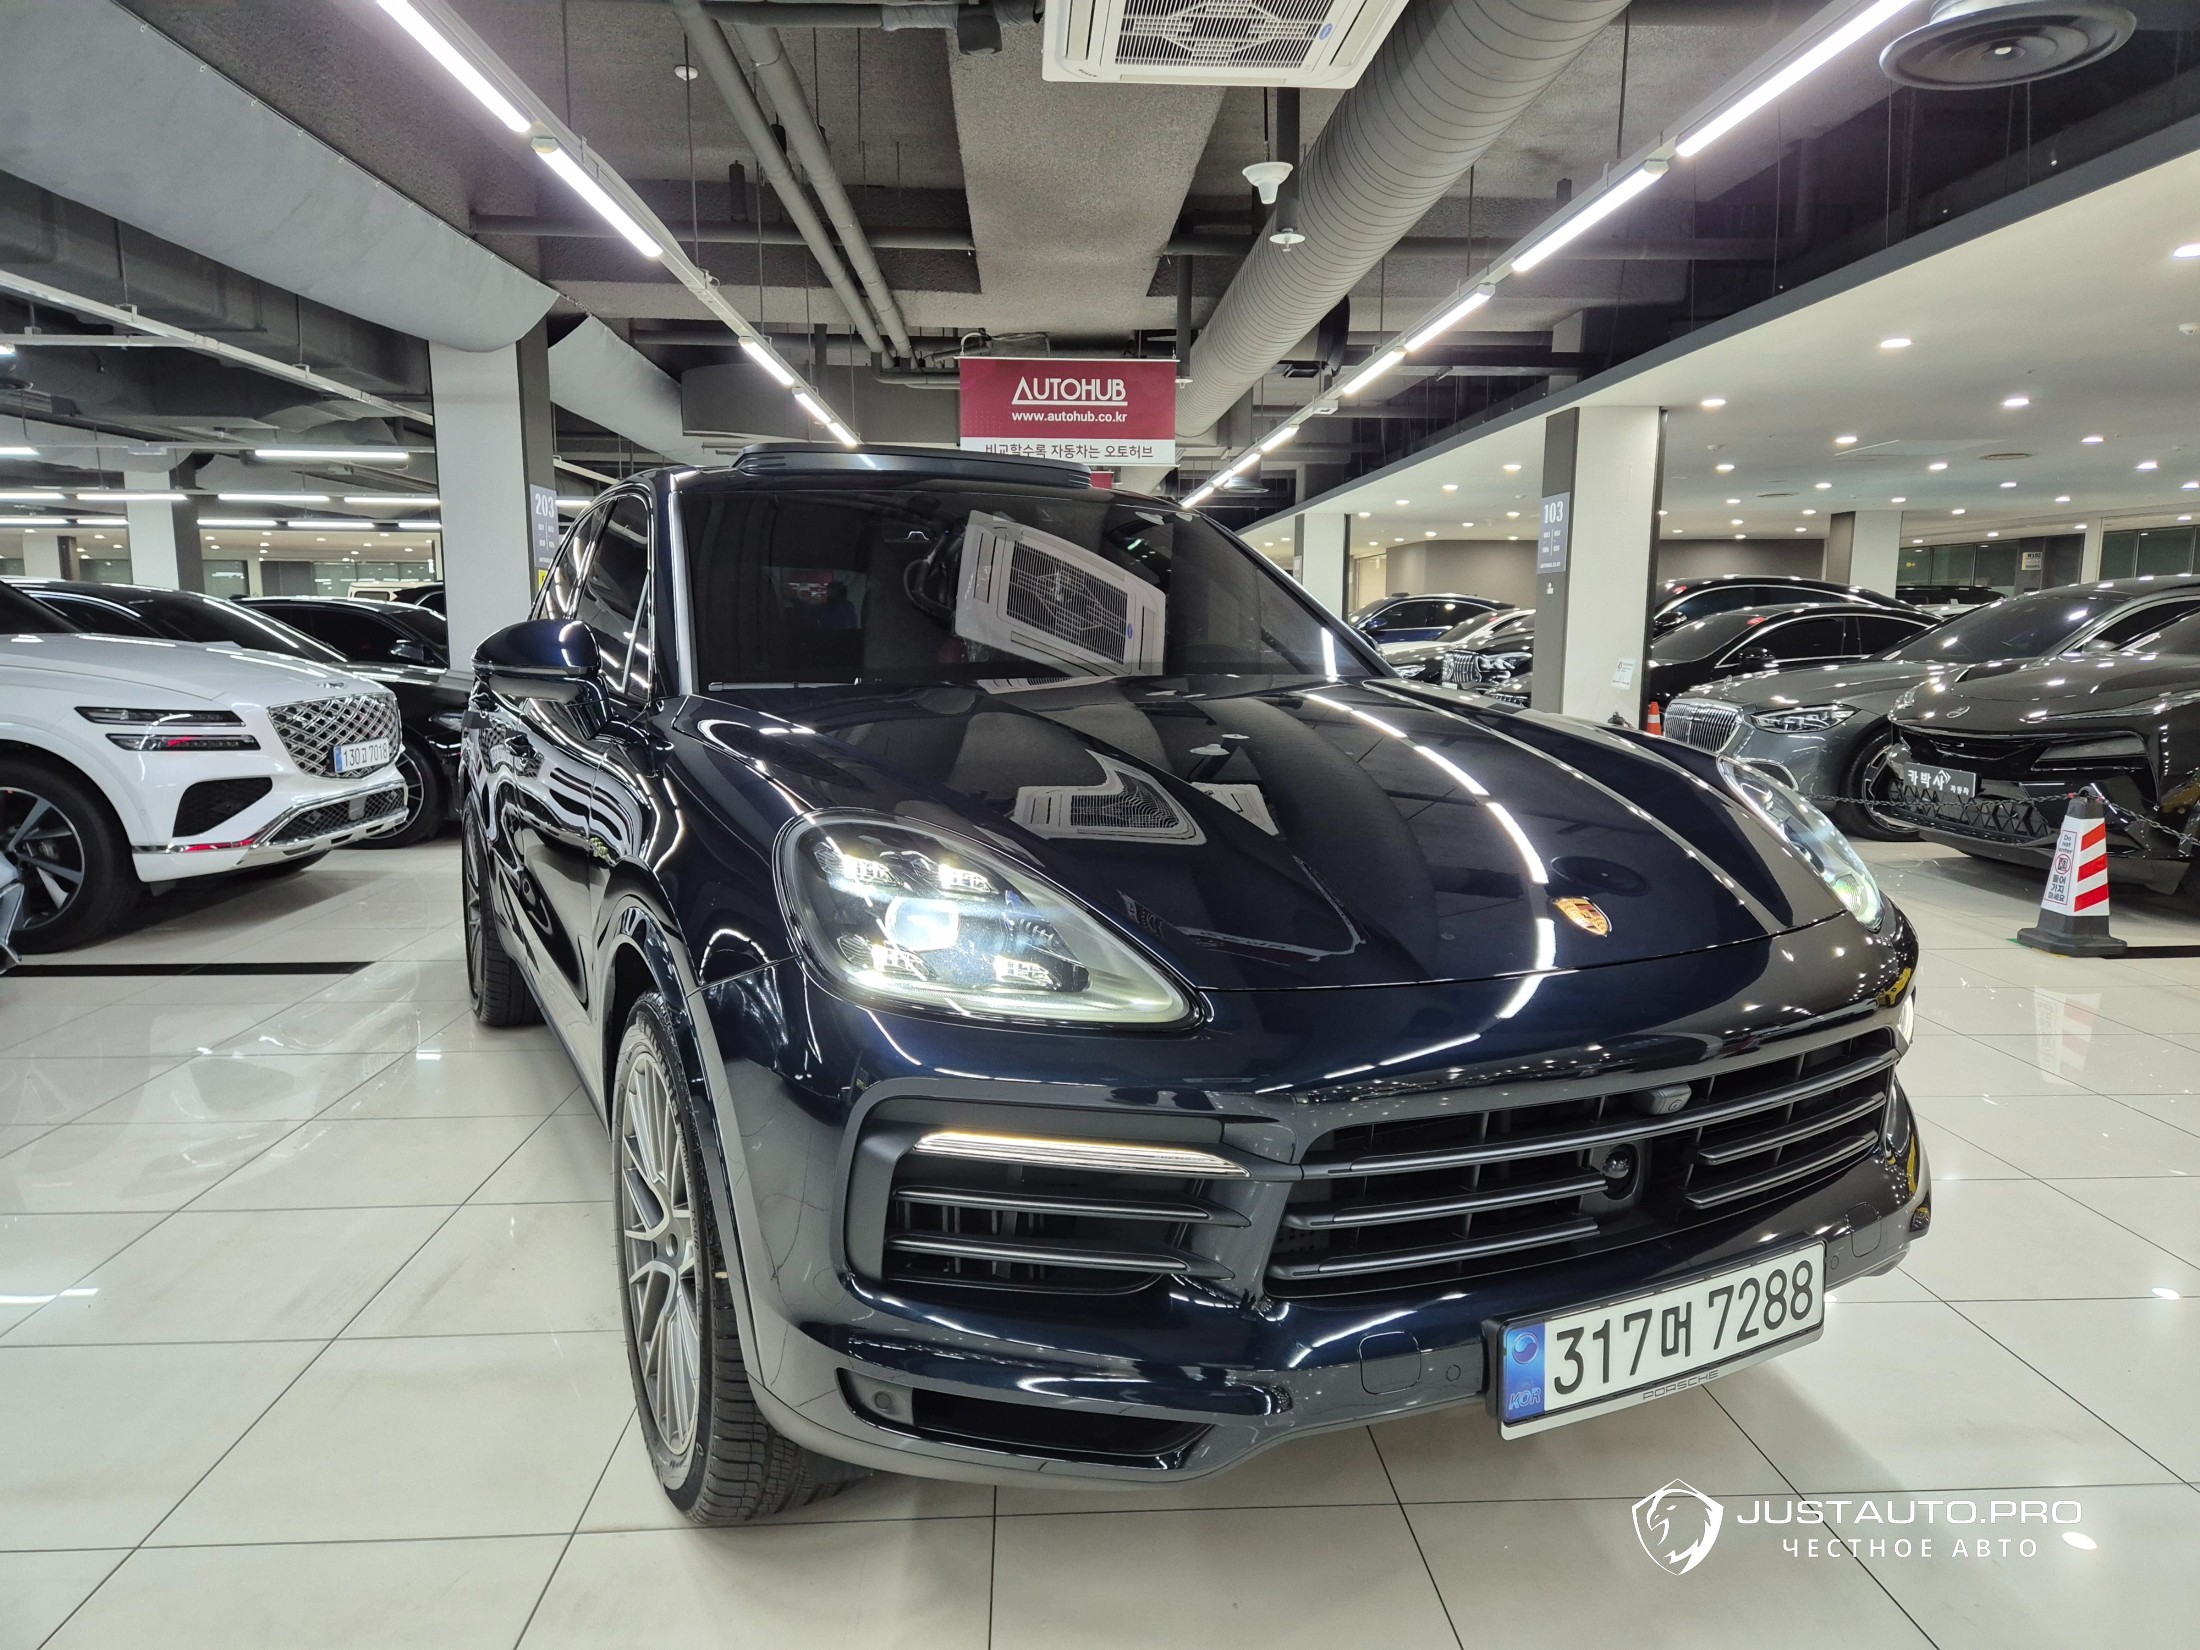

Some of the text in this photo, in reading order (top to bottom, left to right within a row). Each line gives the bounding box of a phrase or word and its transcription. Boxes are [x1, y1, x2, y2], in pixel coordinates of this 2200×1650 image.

[1012, 376, 1128, 406] AUTOHUB
[1012, 410, 1128, 423] www.autohub.co.kr
[1051, 444, 1101, 459] 자동차는
[1104, 445, 1154, 459] 오토허브
[535, 493, 555, 518] 203
[1544, 500, 1564, 524] 103
[1553, 1259, 1814, 1396] 317머 7288
[1642, 1368, 1720, 1401] PORSCHE
[1508, 1387, 1542, 1411] KOR
